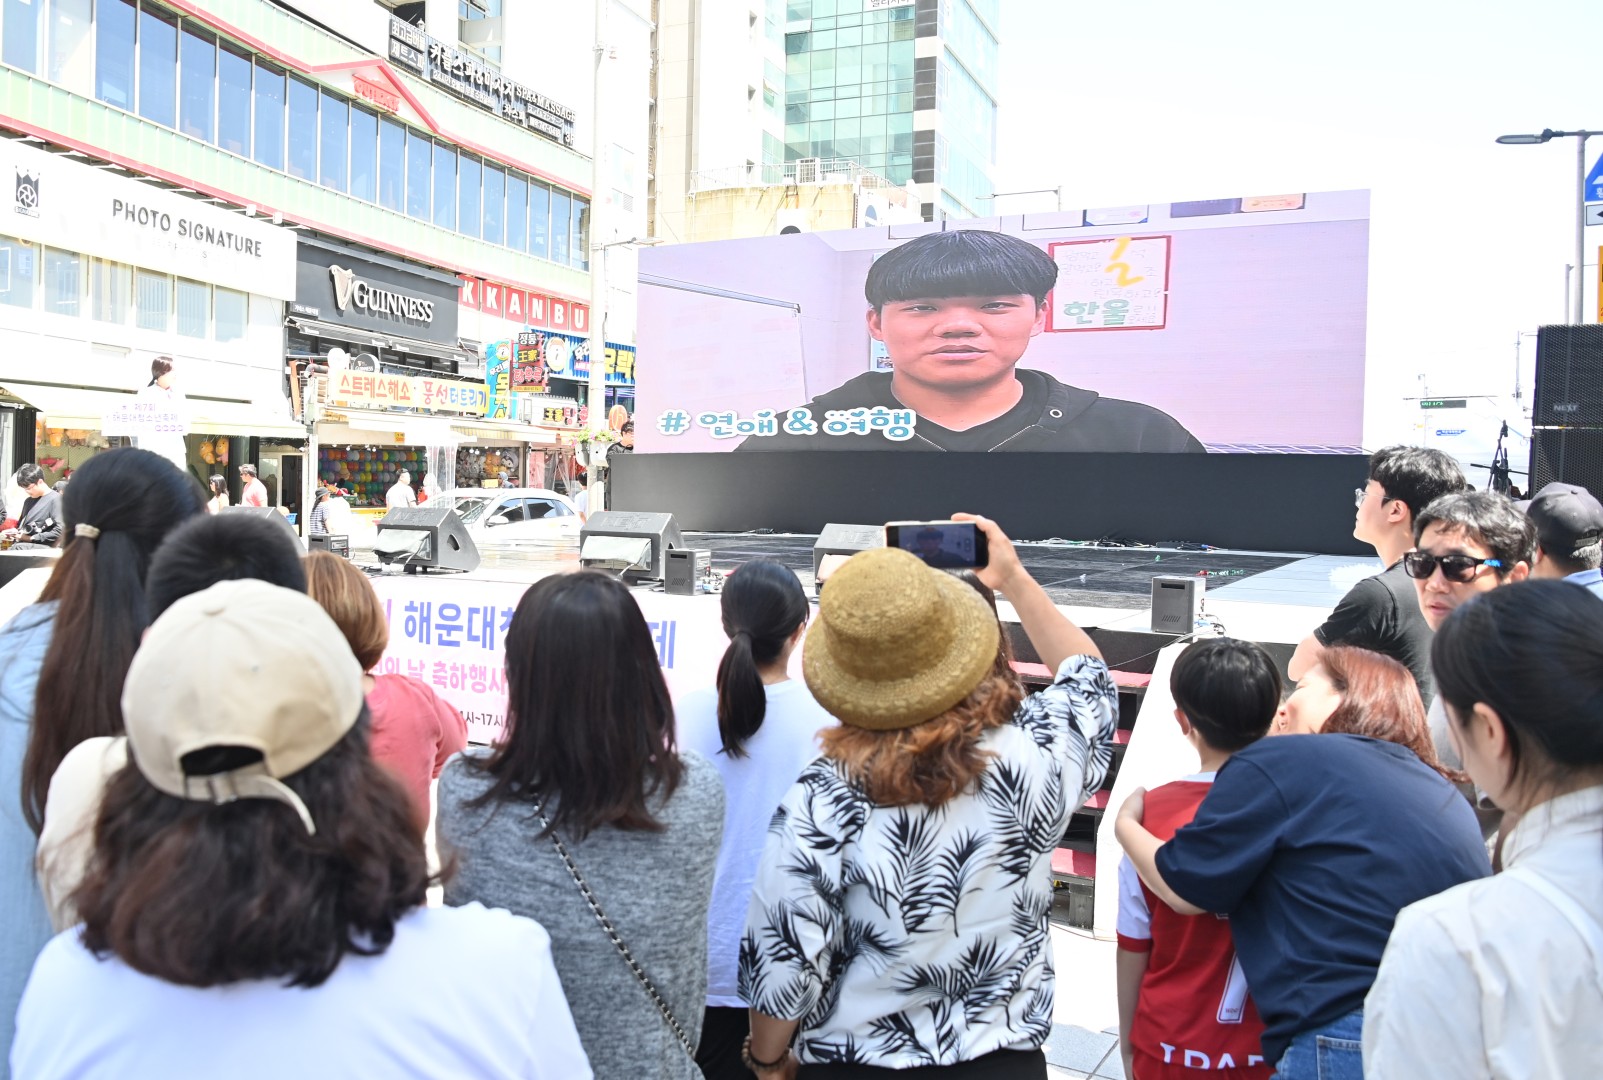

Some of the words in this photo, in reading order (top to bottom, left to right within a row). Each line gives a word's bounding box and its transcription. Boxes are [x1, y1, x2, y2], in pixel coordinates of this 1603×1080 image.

[112, 199, 172, 232] PHOTO
[178, 218, 263, 258] SIGNATURE
[353, 280, 434, 323] GUINNESS
[461, 280, 586, 330] KKANBU
[339, 374, 411, 402] 스트레스해소
[423, 381, 488, 410] 풍선터트리기
[699, 408, 776, 437] 연애
[786, 407, 815, 434] &
[825, 407, 915, 440] 여행
